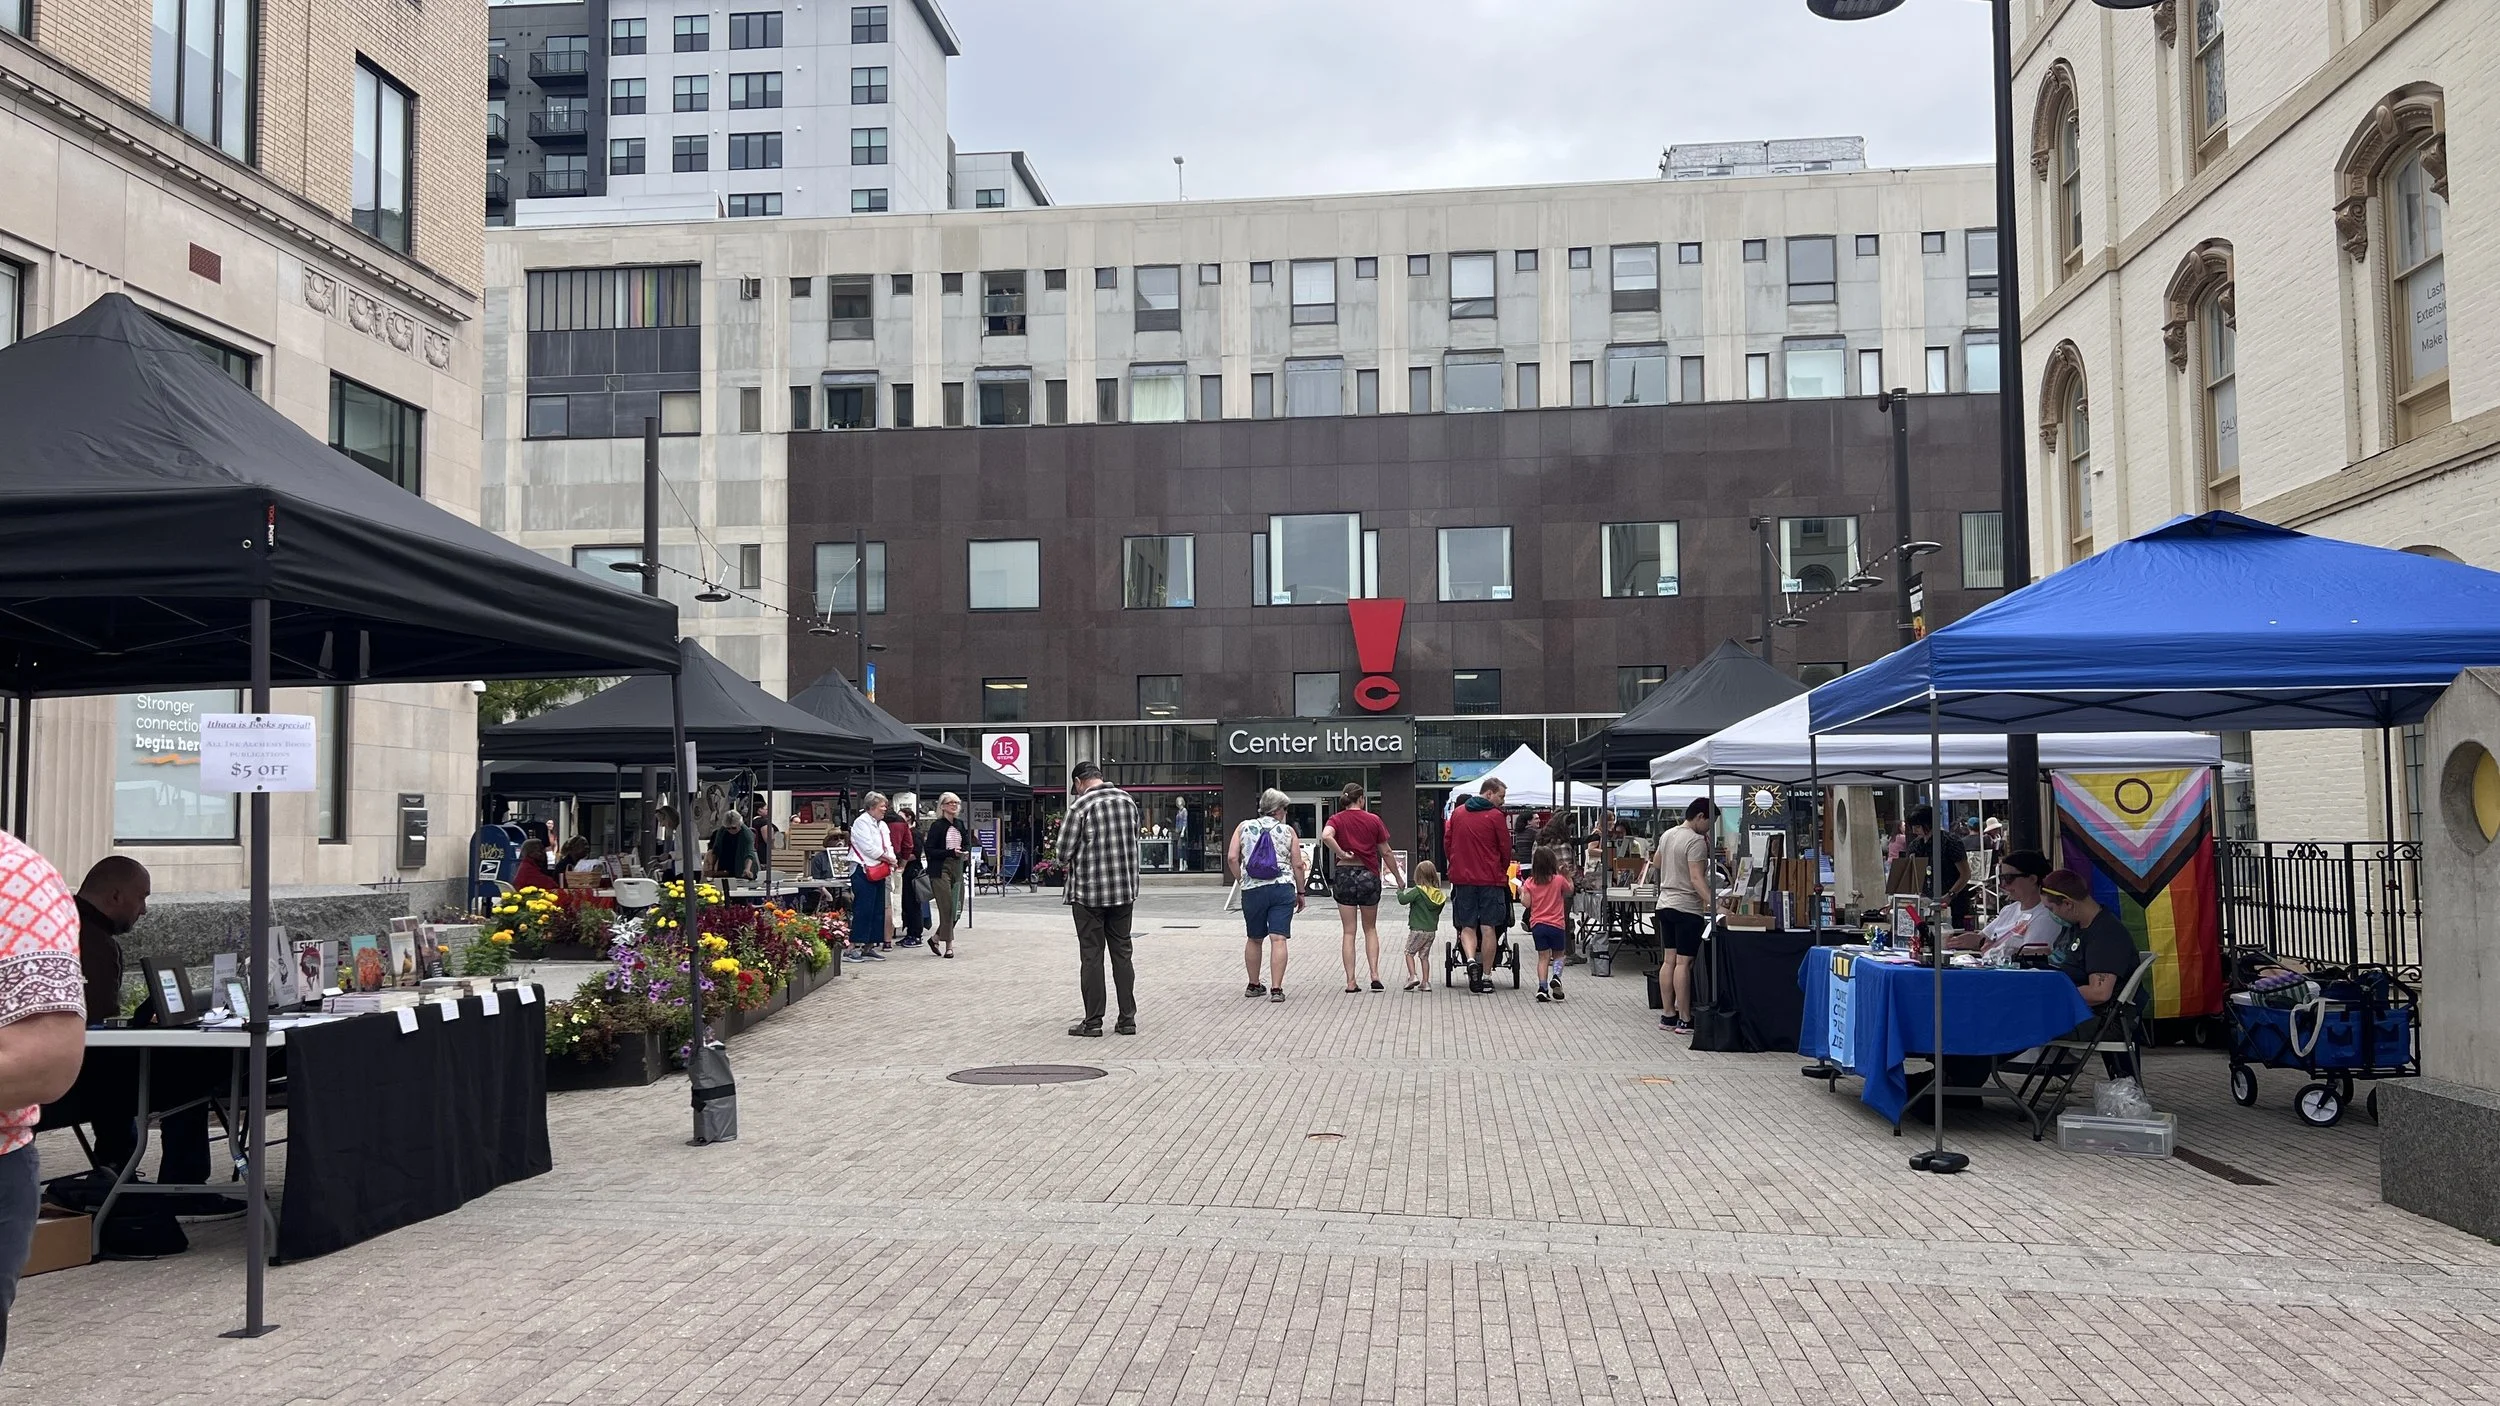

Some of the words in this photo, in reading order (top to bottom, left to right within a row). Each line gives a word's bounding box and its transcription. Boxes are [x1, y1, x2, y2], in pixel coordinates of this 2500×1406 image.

[2426, 281, 2445, 299] Lash
[2421, 333, 2443, 352] Make
[137, 694, 194, 716] Stronger
[136, 716, 201, 733] connectio
[207, 720, 237, 729] Ithaca
[238, 720, 246, 729] is
[250, 720, 276, 729] Books
[135, 733, 175, 752] begin
[177, 736, 202, 752] her
[1229, 729, 1317, 754] Center
[1326, 728, 1403, 753] Ithaca
[231, 761, 252, 779] $5
[258, 765, 289, 776] OFF
